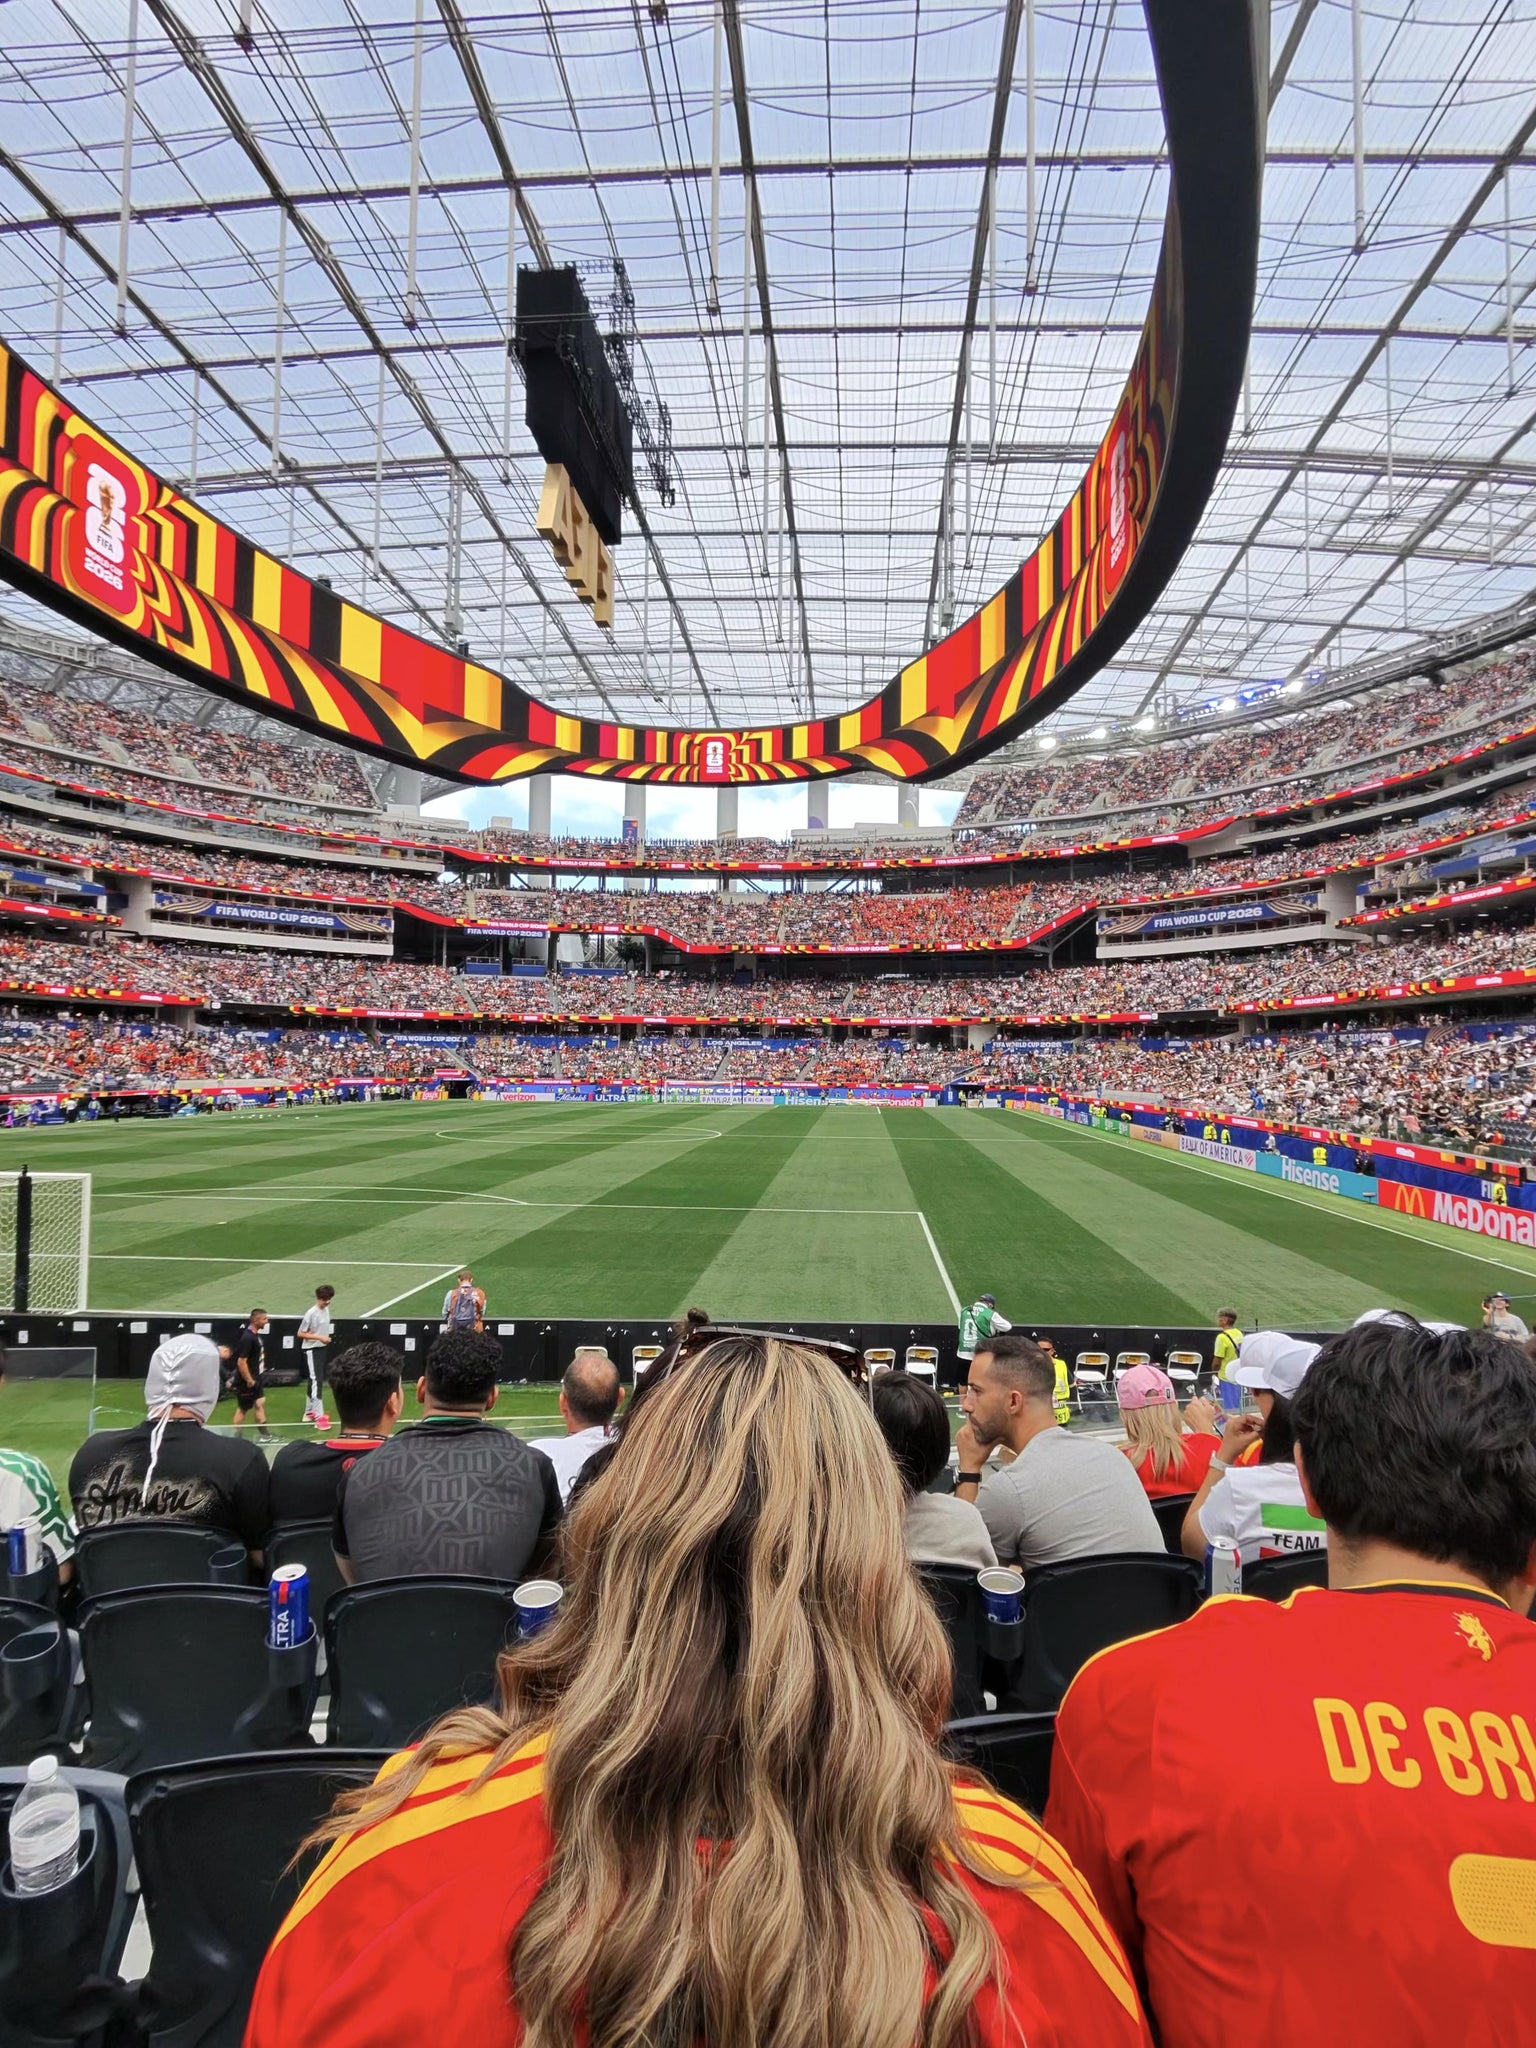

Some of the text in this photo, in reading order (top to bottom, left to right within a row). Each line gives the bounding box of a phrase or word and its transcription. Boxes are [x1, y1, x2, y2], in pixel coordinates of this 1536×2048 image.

[97, 535, 114, 553] FIFA
[84, 556, 124, 591] 2026
[215, 906, 334, 926] FIFA WORLD CUP 2026
[1154, 907, 1263, 928] FIFA WORLD CUP 2026
[482, 928, 506, 936] WORLD
[520, 930, 543, 938] 2026
[503, 1092, 536, 1101] verizon
[595, 1094, 626, 1102] ULTRA
[1181, 1137, 1244, 1166] BANK OF AMERICA
[1281, 1157, 1340, 1194] Hisense
[1272, 1533, 1320, 1550] TEAM
[1313, 1697, 1422, 1789] DE
